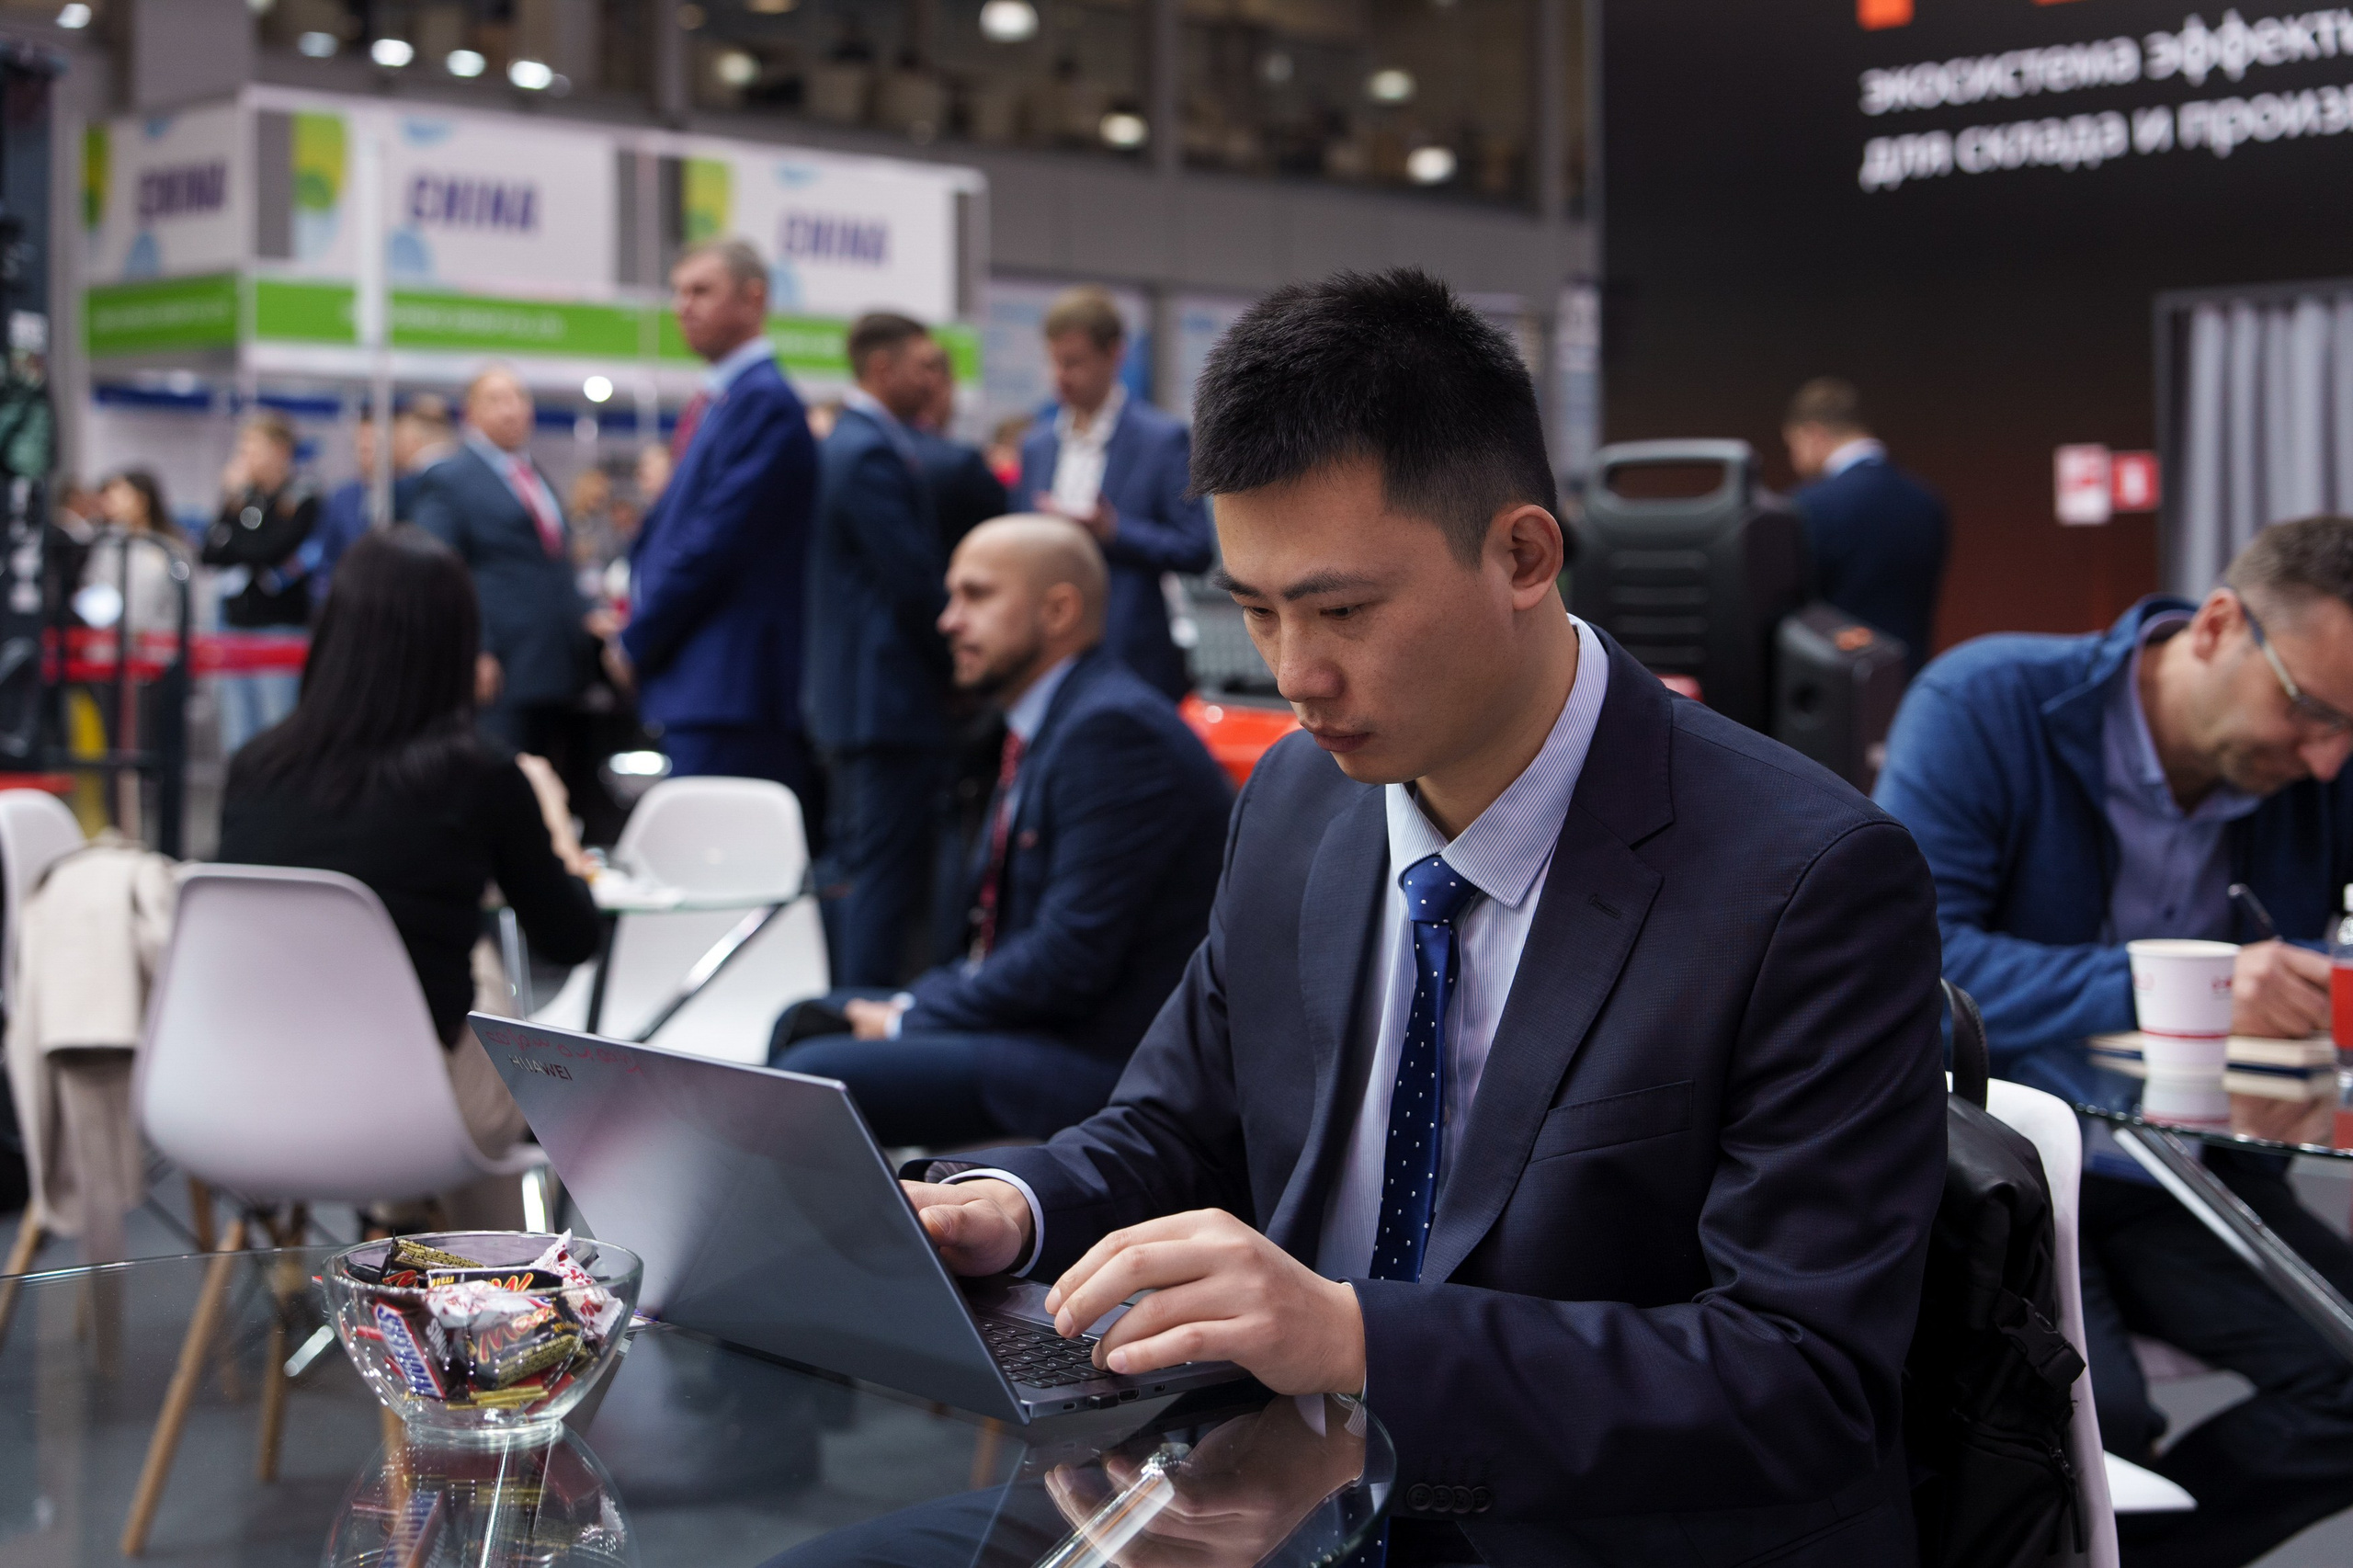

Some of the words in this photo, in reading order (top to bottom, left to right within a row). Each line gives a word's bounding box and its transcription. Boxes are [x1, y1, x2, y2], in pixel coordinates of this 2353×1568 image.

[1859, 37, 2142, 116] экосистема
[1859, 130, 1954, 193] для
[1955, 110, 2129, 172] склада
[2131, 105, 2174, 154] и
[2177, 84, 2353, 160] произ
[137, 160, 229, 222] CHINA
[408, 173, 541, 236] CHINA
[779, 209, 892, 267] CHINA
[508, 1054, 573, 1081] HUAWEI
[377, 1304, 437, 1397] NICKERS
